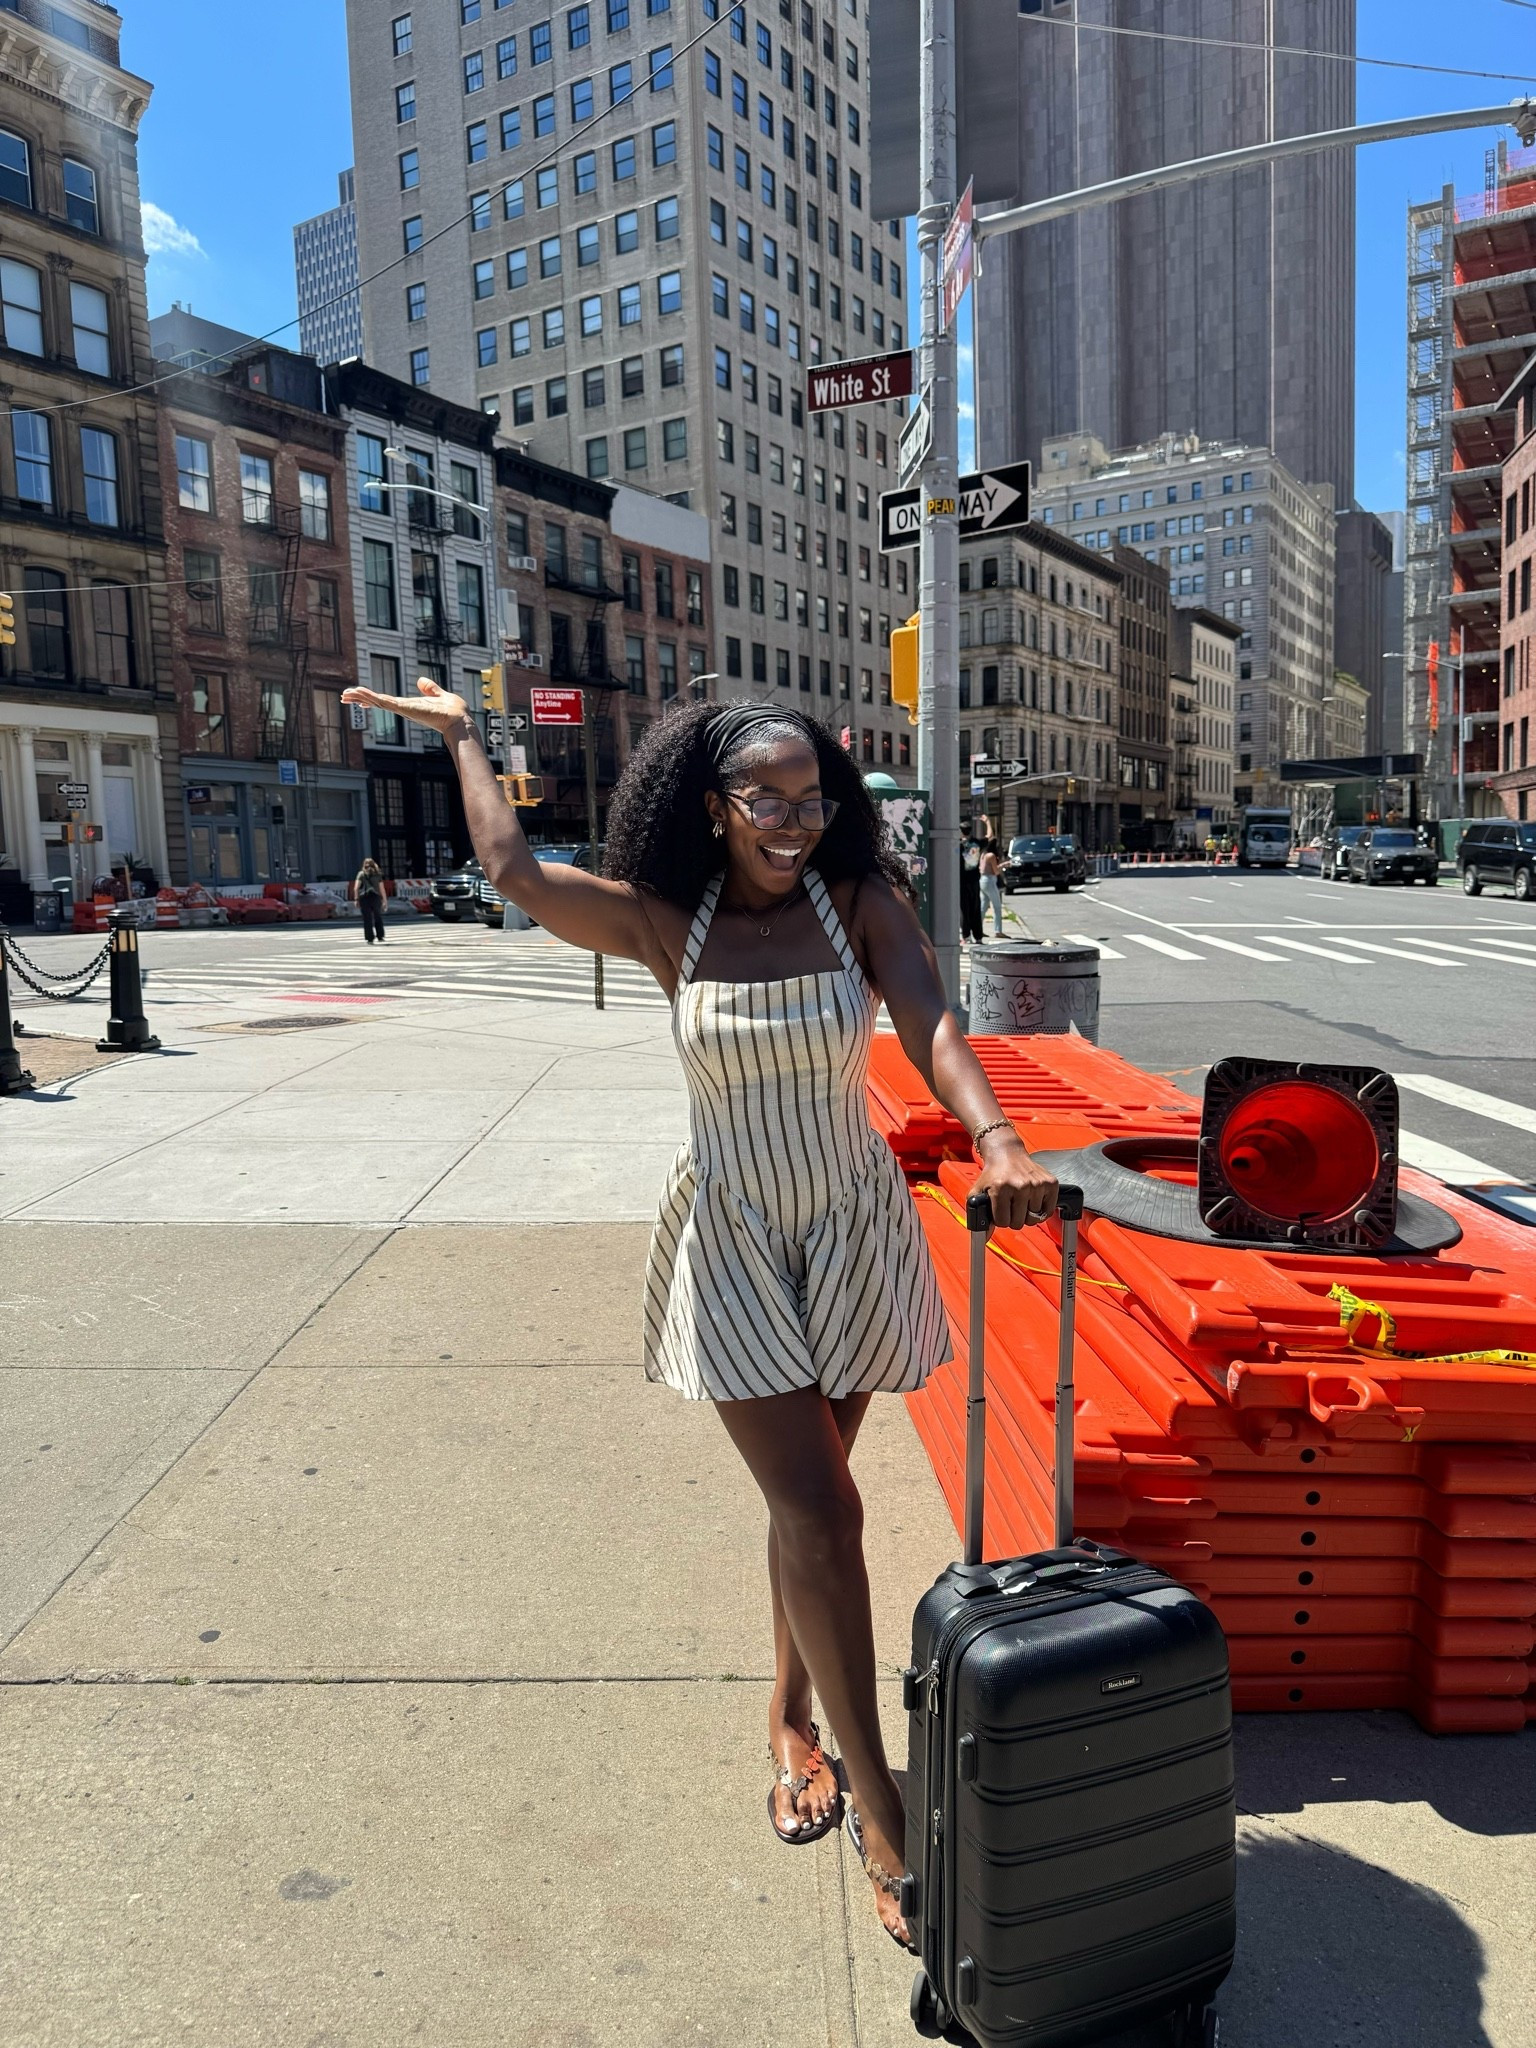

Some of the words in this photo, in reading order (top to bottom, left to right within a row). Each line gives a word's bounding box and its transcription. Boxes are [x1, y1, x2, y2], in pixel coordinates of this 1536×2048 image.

[814, 373, 864, 406] White
[871, 367, 891, 397] St
[896, 504, 921, 530] ON
[534, 692, 544, 700] NO
[545, 692, 576, 700] STANDING
[535, 700, 562, 708] Anytime
[1067, 1251, 1076, 1299] Rockland
[1108, 1676, 1135, 1689] Rockland
